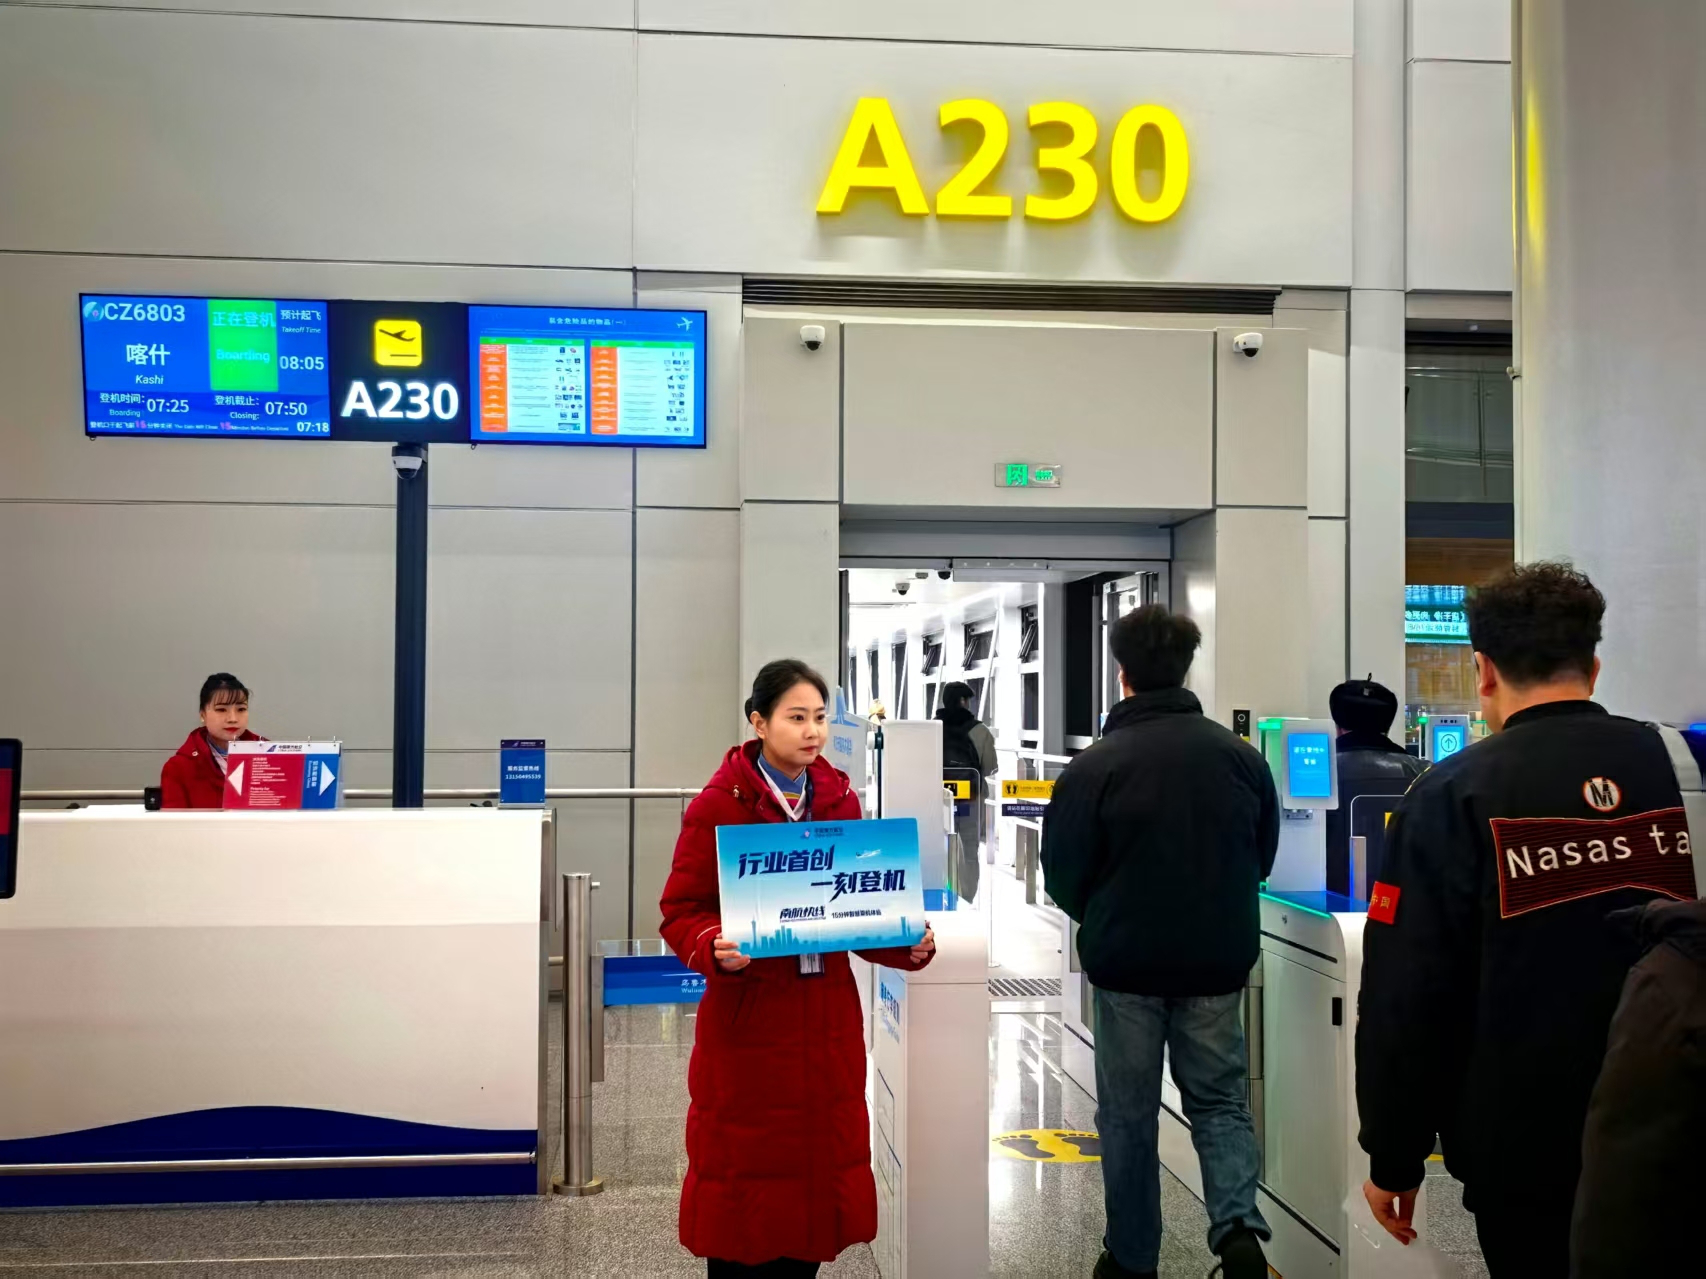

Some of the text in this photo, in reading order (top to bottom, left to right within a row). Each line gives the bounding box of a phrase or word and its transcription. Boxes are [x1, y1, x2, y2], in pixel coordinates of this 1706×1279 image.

[815, 97, 1190, 223] A230
[104, 302, 186, 322] CZ6803
[212, 311, 276, 327] 正在登机
[280, 309, 322, 321] 预计起飞
[126, 343, 171, 366] 喀什
[216, 349, 270, 364] Boarding
[279, 355, 325, 371] 08:05
[135, 374, 164, 385] Kashi
[146, 398, 190, 413] 07:25
[340, 380, 459, 420] A230
[265, 401, 308, 416] 07:50
[296, 421, 330, 433] 07:18
[738, 844, 836, 880] 行业首创
[1505, 836, 1633, 879] Nasas
[810, 869, 906, 903] 一刻登机
[780, 905, 826, 919] 南航快线
